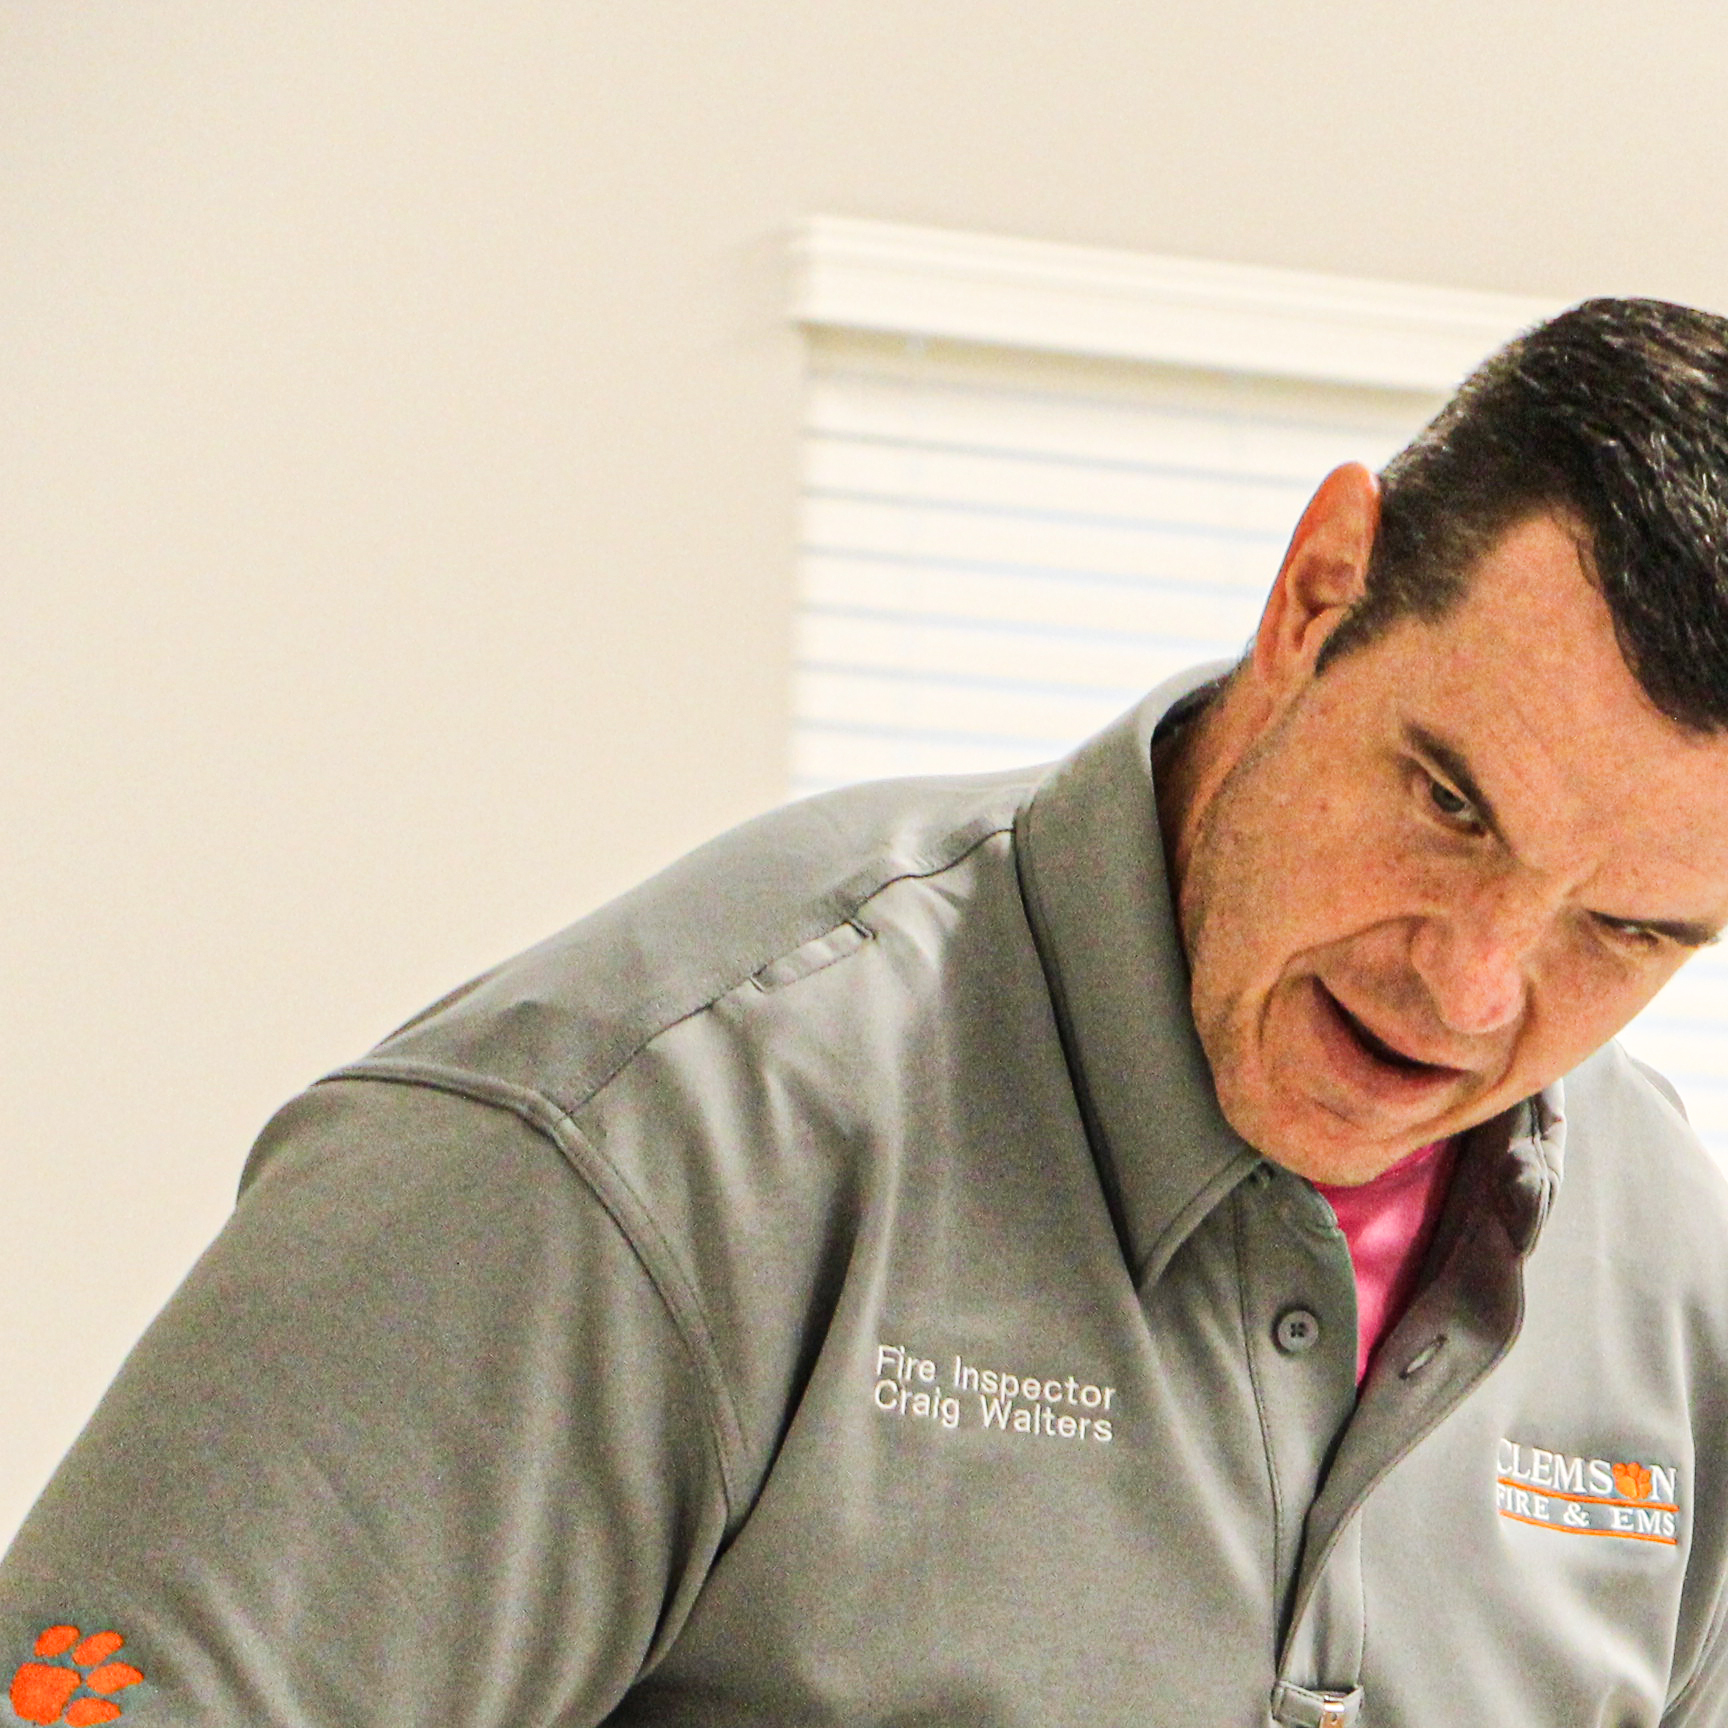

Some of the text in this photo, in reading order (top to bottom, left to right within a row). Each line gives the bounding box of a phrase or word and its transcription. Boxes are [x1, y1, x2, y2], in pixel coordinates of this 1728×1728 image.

[876, 1344, 1117, 1410] Fire Inspector
[874, 1379, 1113, 1442] Craig Walters
[1496, 1437, 1677, 1502] CLEMSN
[1496, 1483, 1676, 1537] FIRE & EMS
